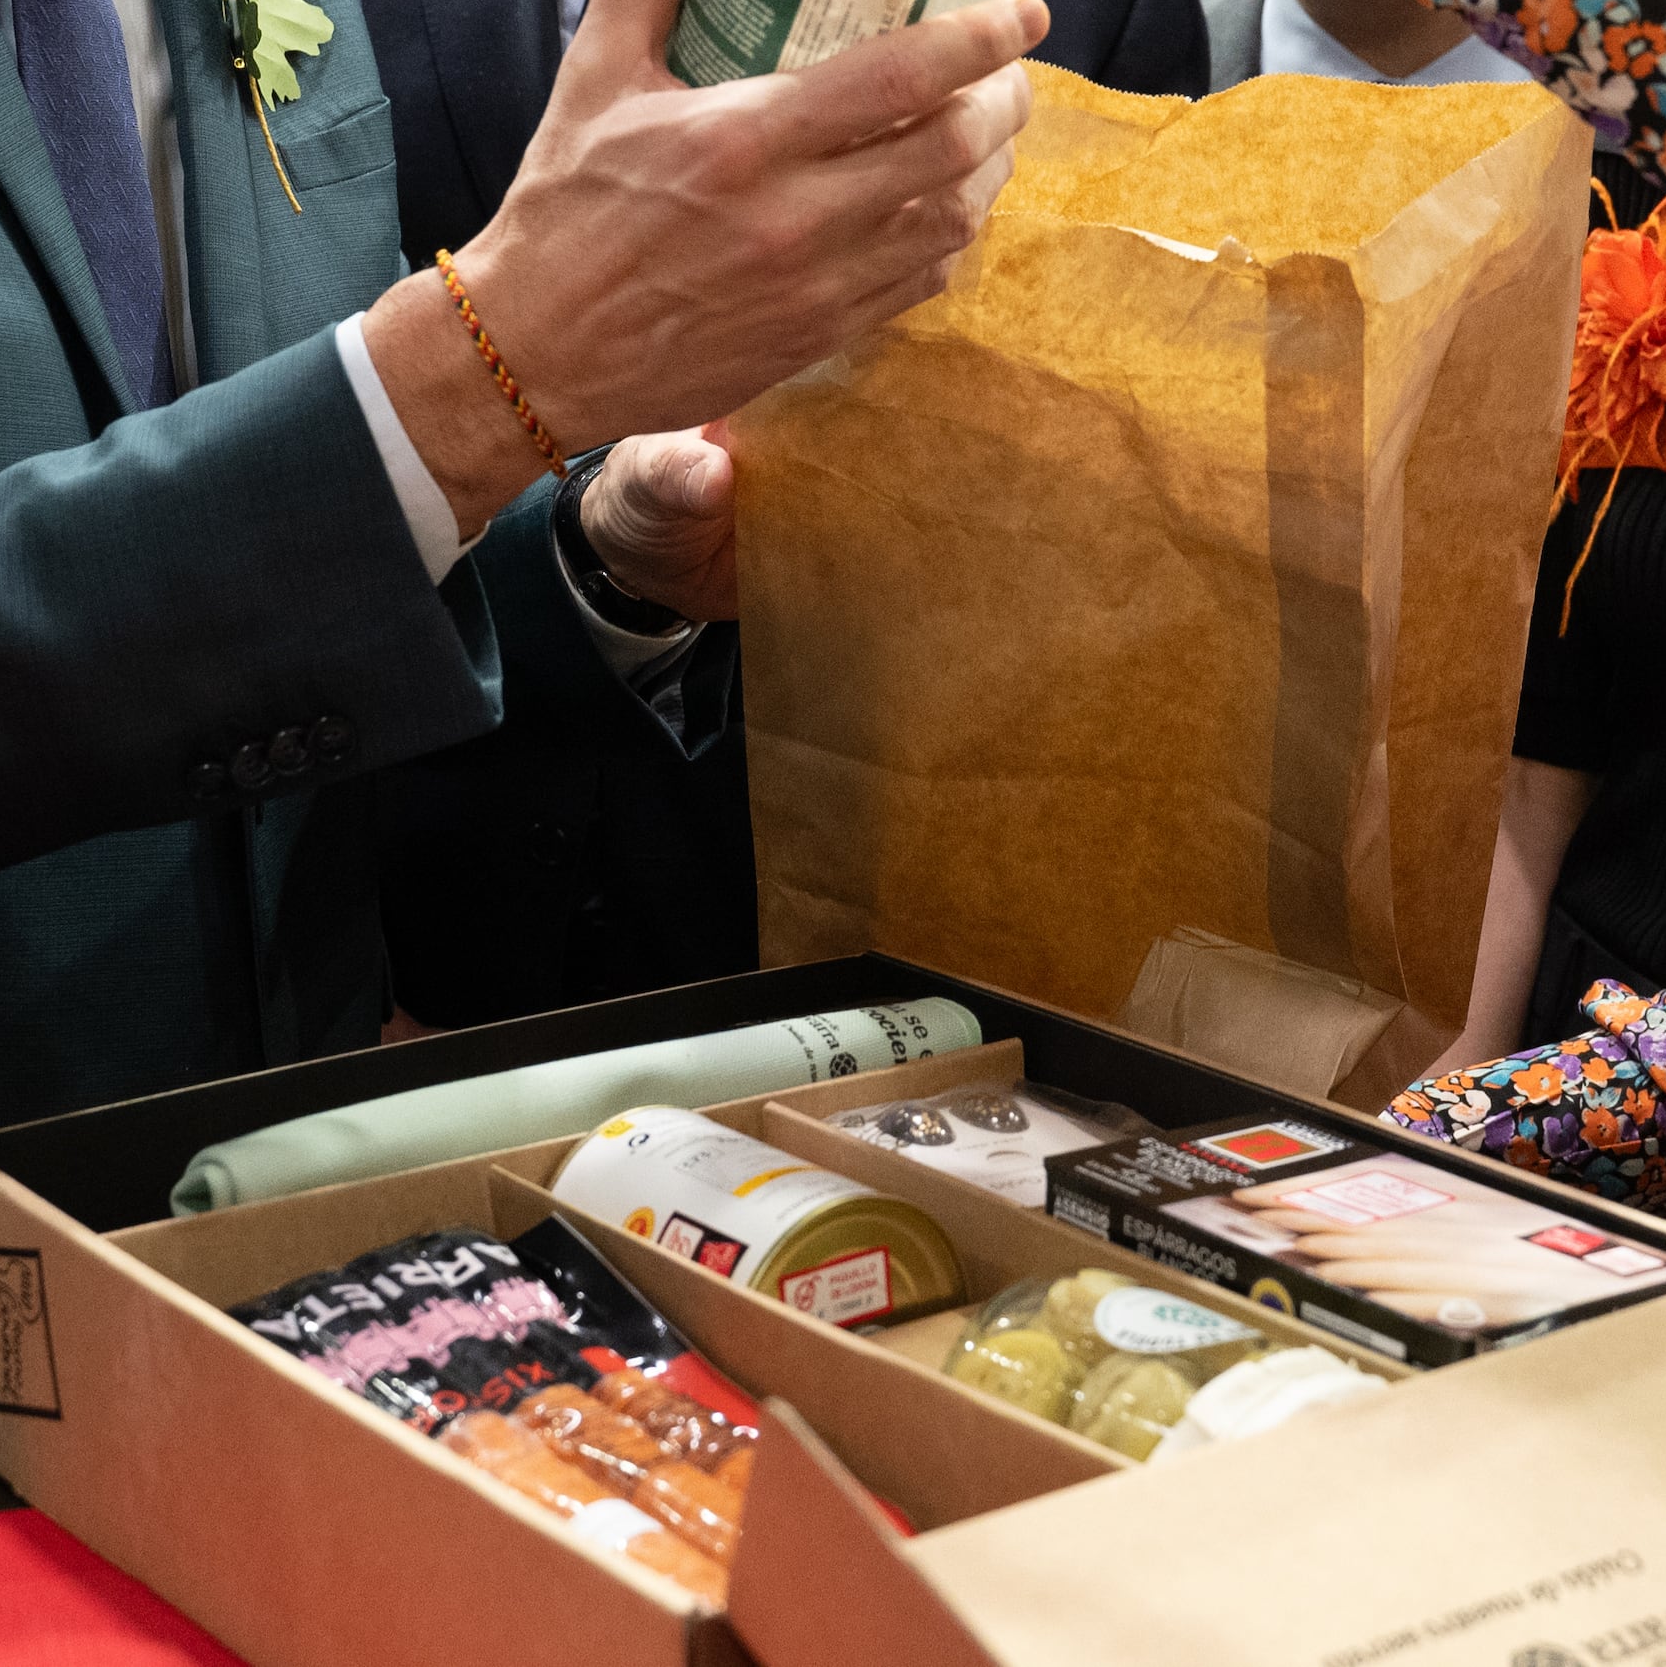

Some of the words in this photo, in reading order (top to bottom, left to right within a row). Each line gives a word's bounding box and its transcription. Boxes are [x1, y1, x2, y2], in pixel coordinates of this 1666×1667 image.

[904, 1015, 930, 1040] se
[1123, 1214, 1238, 1281] ESPÁRRAGOS
[250, 1240, 520, 1341] ARRIETA
